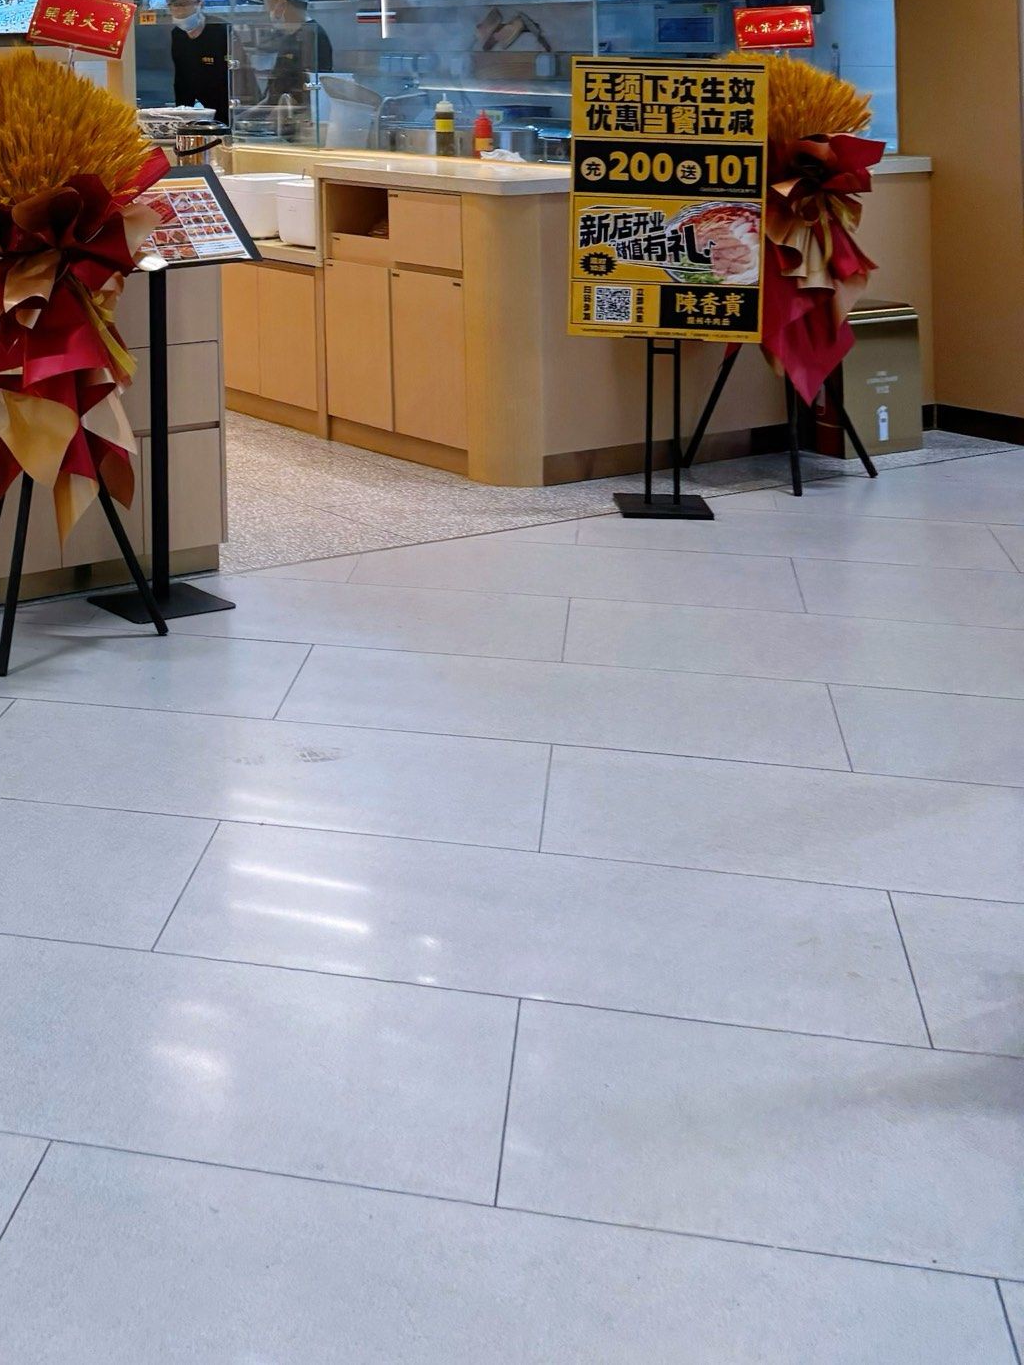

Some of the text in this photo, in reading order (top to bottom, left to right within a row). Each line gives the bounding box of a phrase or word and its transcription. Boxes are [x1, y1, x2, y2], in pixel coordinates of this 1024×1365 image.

[585, 72, 755, 105] 无须下次生效
[585, 104, 754, 136] 优惠当餐立减
[580, 212, 665, 247] 新店开业
